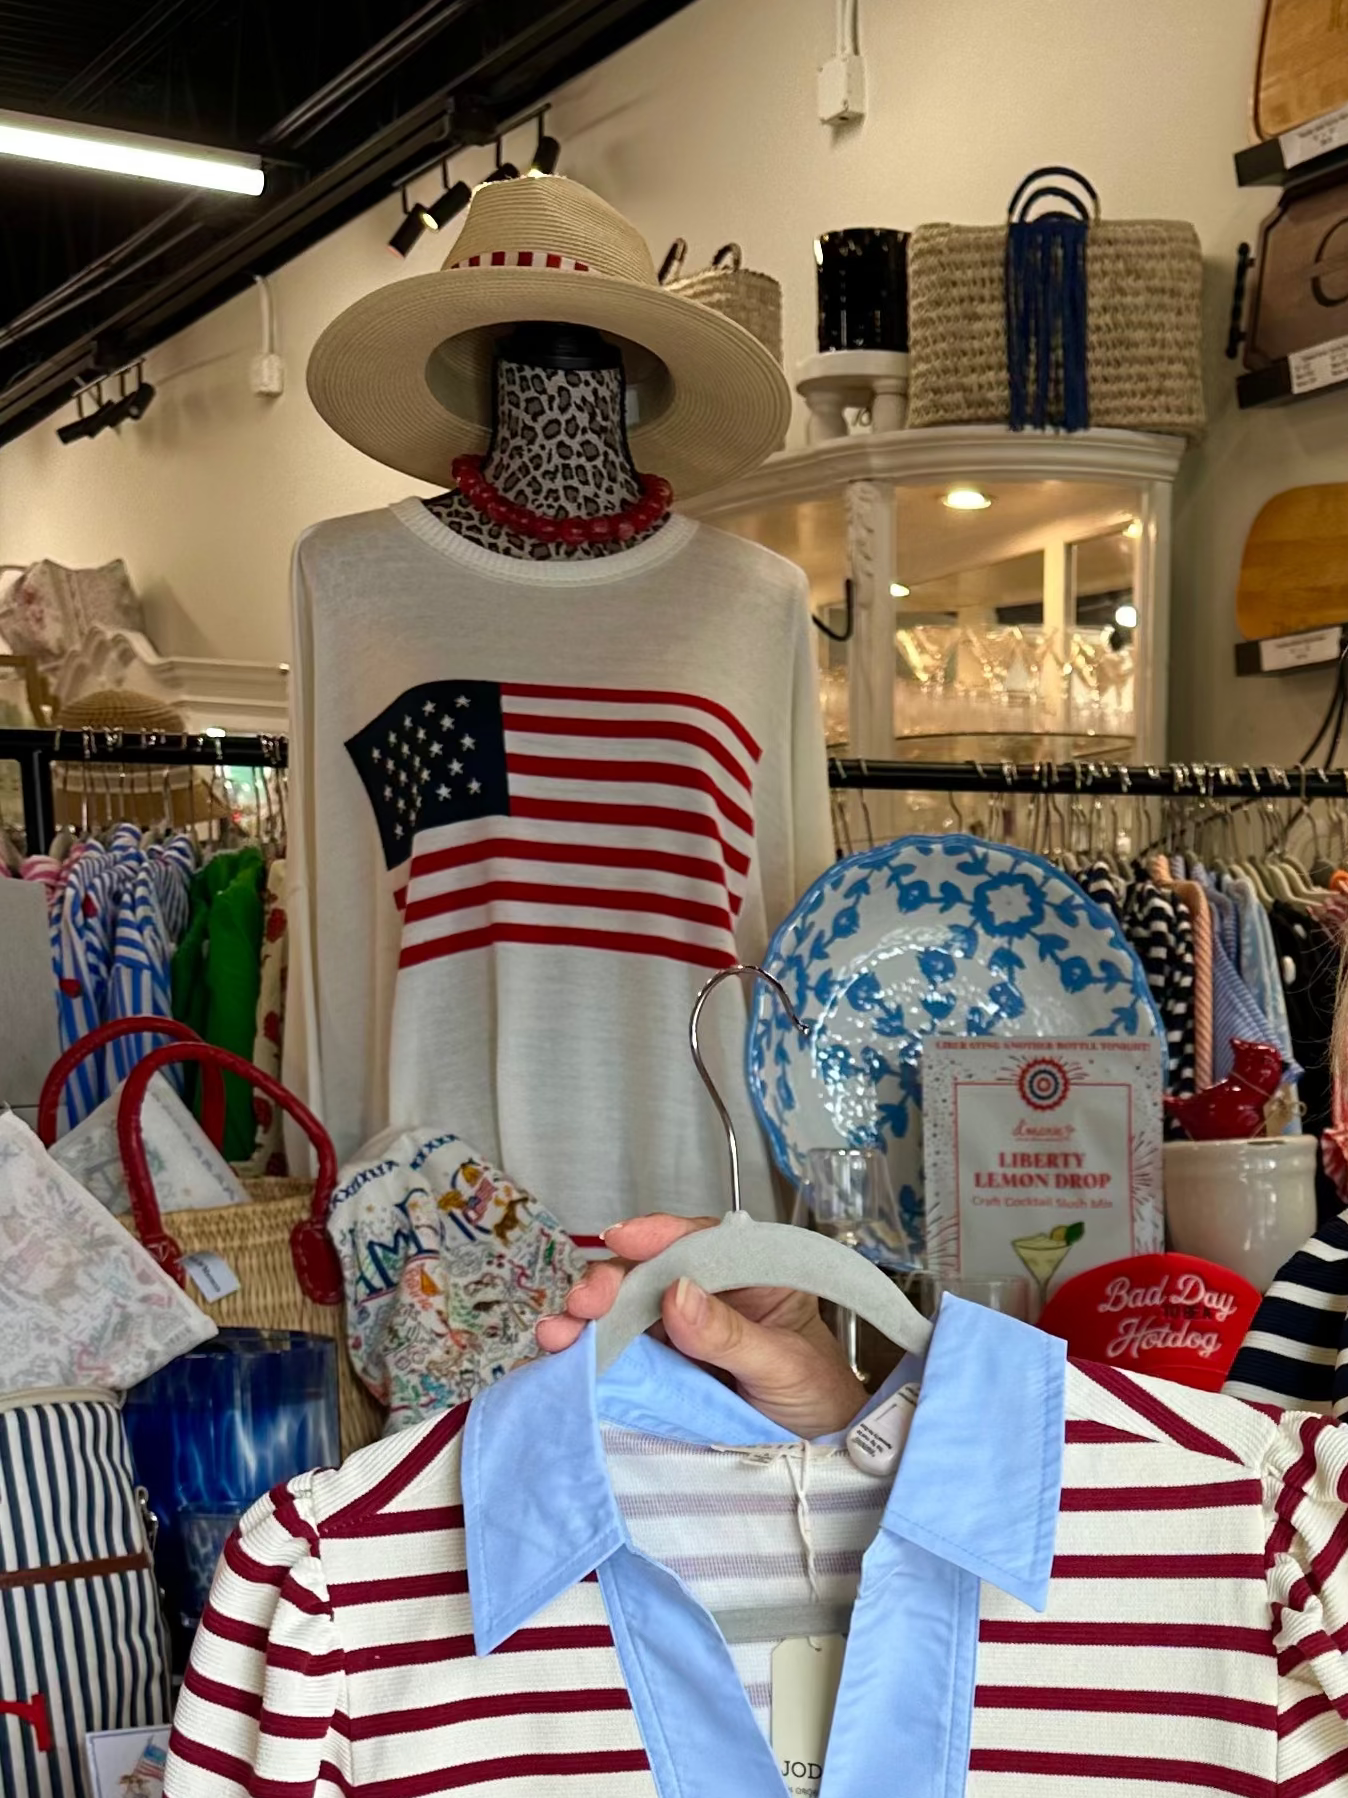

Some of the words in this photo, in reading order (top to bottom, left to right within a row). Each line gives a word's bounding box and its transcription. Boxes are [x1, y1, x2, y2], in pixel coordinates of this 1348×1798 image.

[998, 1152, 1086, 1169] LIBERTY
[973, 1172, 1049, 1188] LEMON
[1055, 1173, 1112, 1189] DROP
[1097, 1274, 1168, 1313] Bad
[1168, 1273, 1238, 1322] Day
[1106, 1316, 1222, 1358] Hotdog
